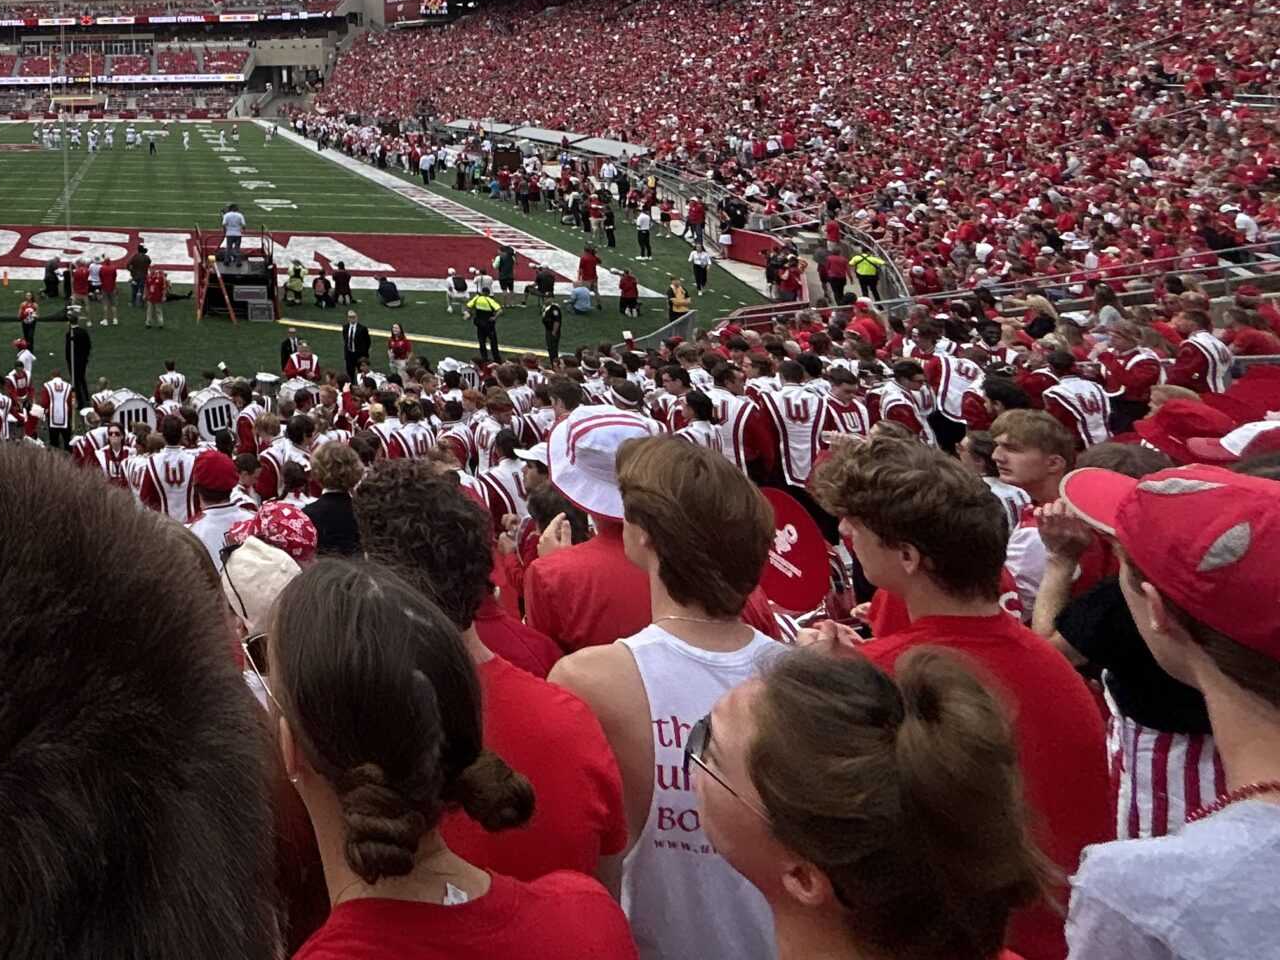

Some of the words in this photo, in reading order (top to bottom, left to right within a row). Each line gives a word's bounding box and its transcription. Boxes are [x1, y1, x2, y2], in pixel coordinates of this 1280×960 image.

[785, 397, 811, 424] W
[163, 460, 186, 488] W
[658, 807, 701, 833] BO
